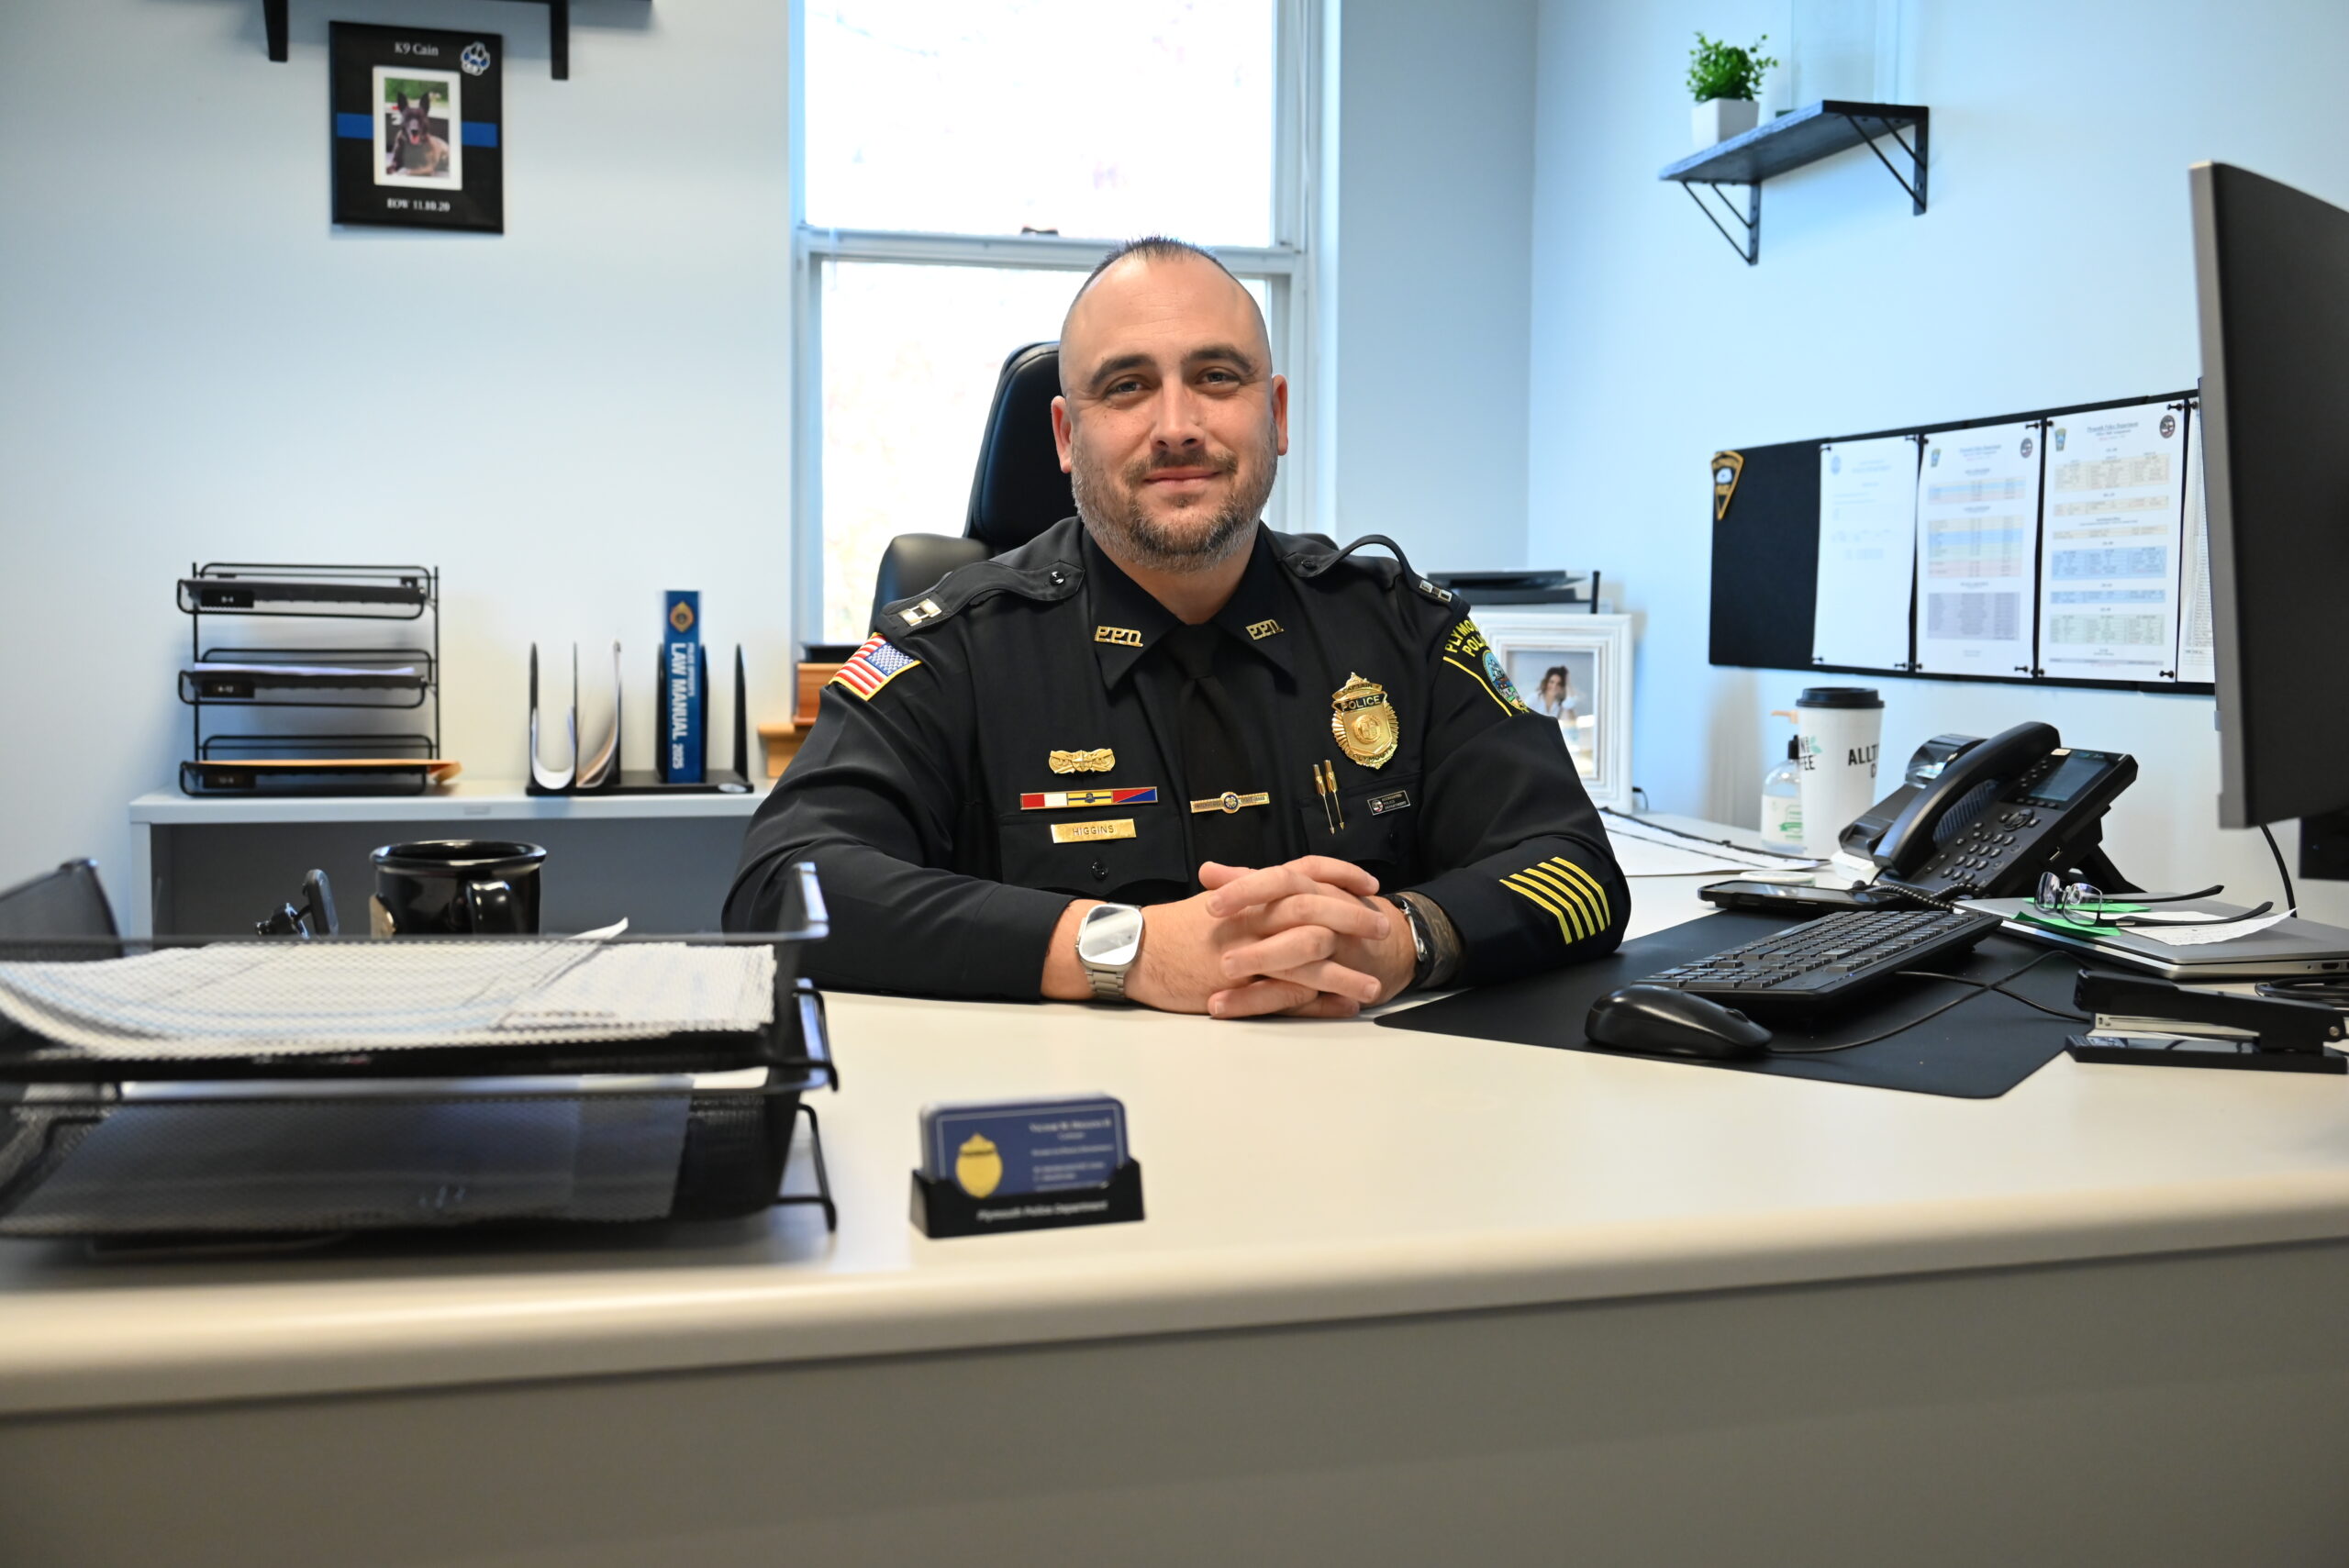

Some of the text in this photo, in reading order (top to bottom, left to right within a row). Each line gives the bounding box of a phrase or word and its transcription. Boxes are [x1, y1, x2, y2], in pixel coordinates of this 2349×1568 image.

[395, 42, 439, 56] K9 Cain
[1095, 626, 1143, 647] PPD
[1246, 618, 1285, 640] PPD
[671, 642, 687, 675] LAW
[1341, 683, 1373, 694] CAPTAIN
[671, 678, 688, 740] MANUAL
[1341, 695, 1381, 712] POLICE
[1352, 745, 1394, 762] PLYMOUTH
[1072, 825, 1115, 836] HIGGINS
